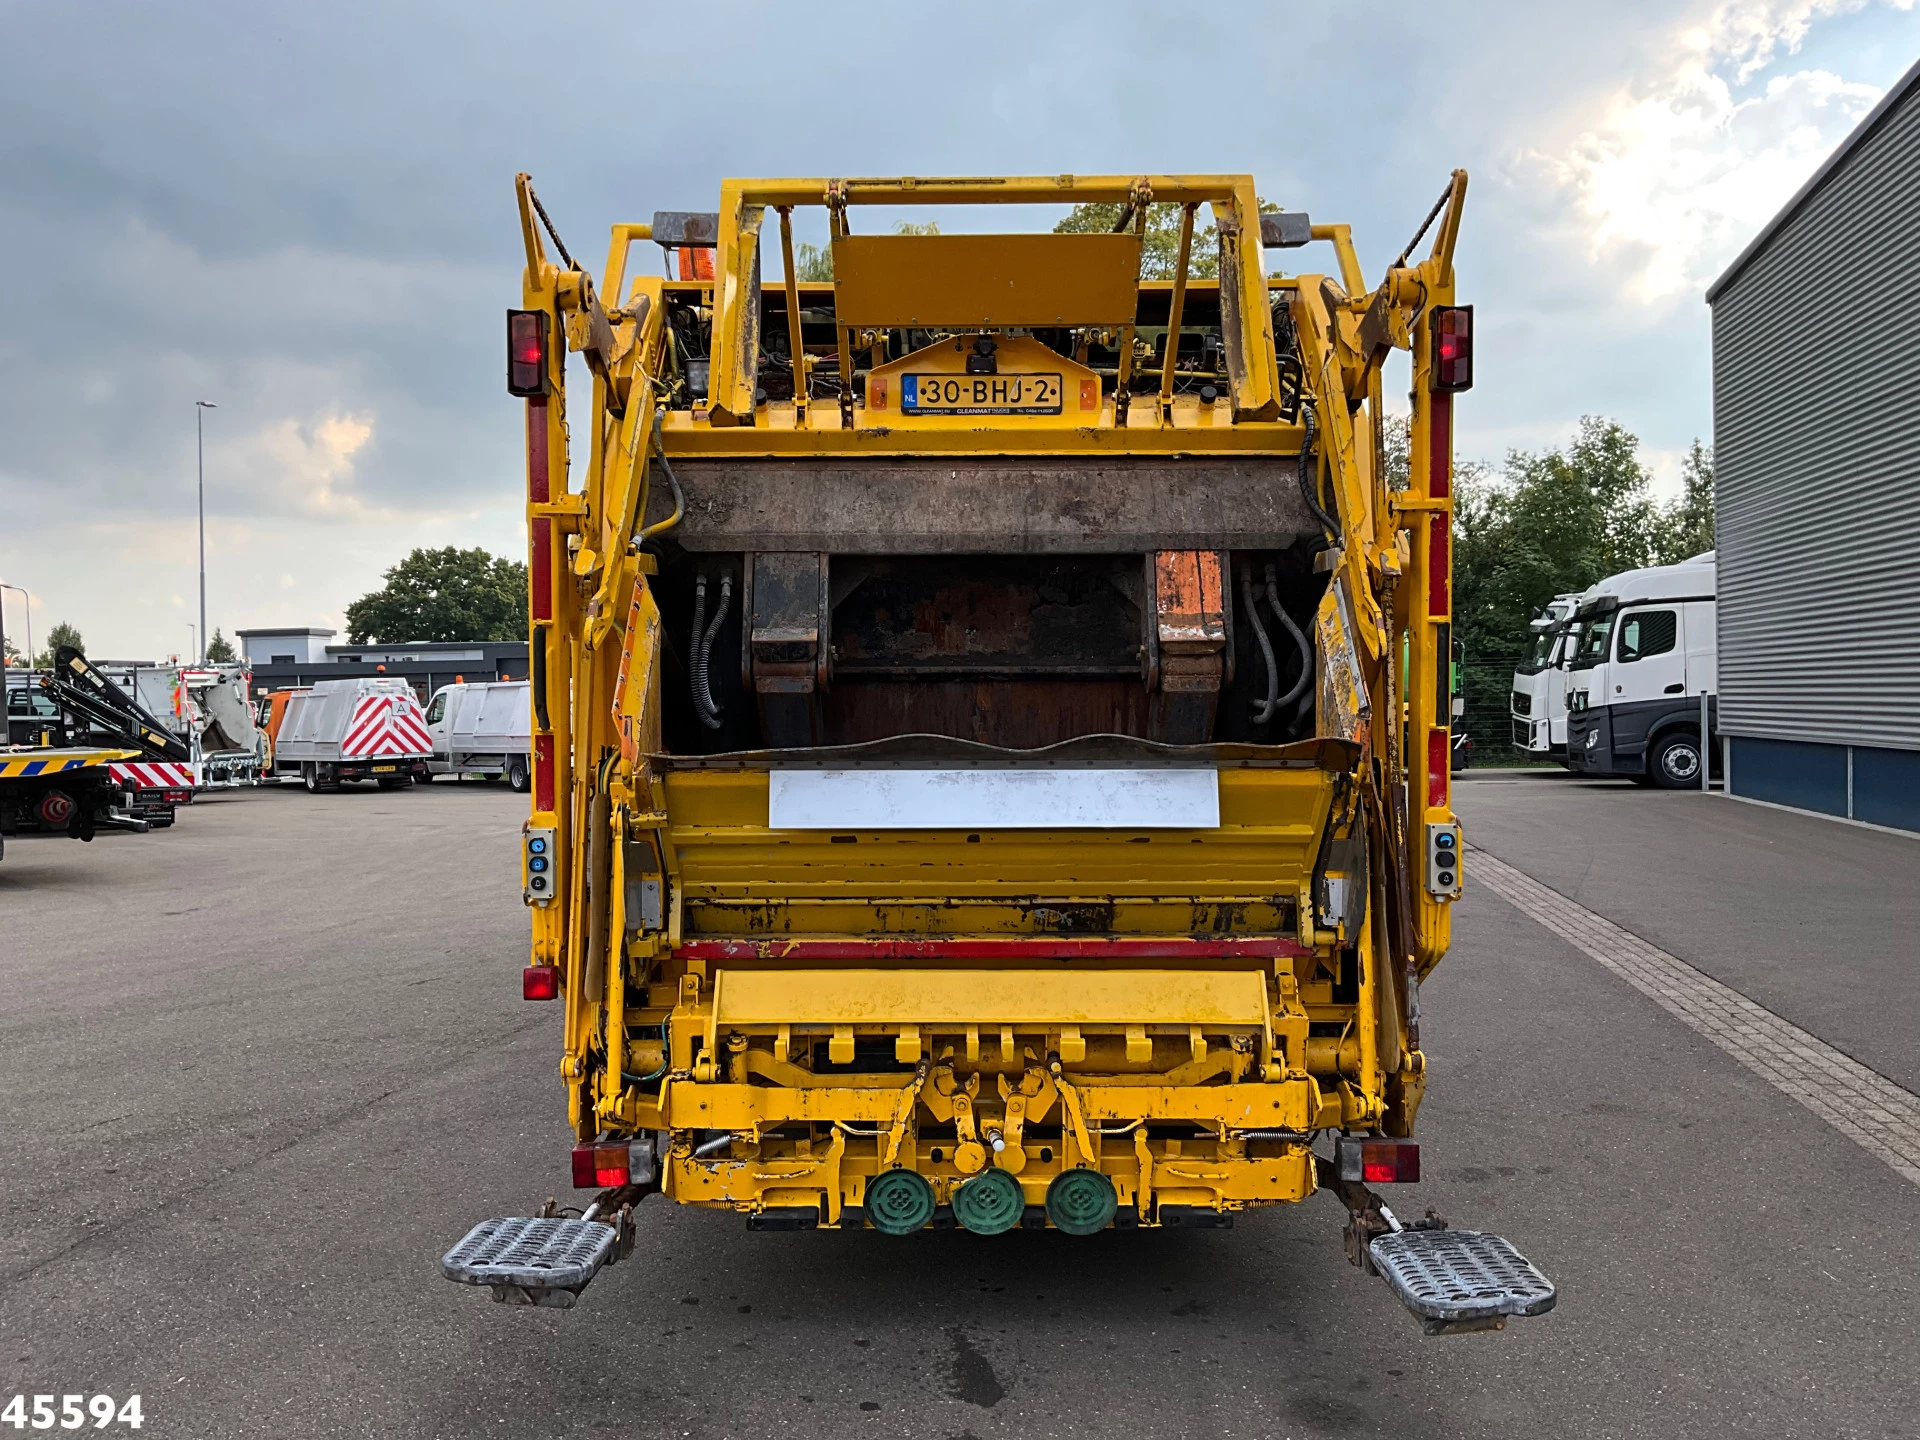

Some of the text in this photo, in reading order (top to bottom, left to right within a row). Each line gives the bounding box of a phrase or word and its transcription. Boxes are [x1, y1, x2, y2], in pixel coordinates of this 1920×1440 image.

[926, 379, 1050, 403] 30-BHJ-2
[904, 395, 916, 403] NL
[396, 704, 406, 714] A
